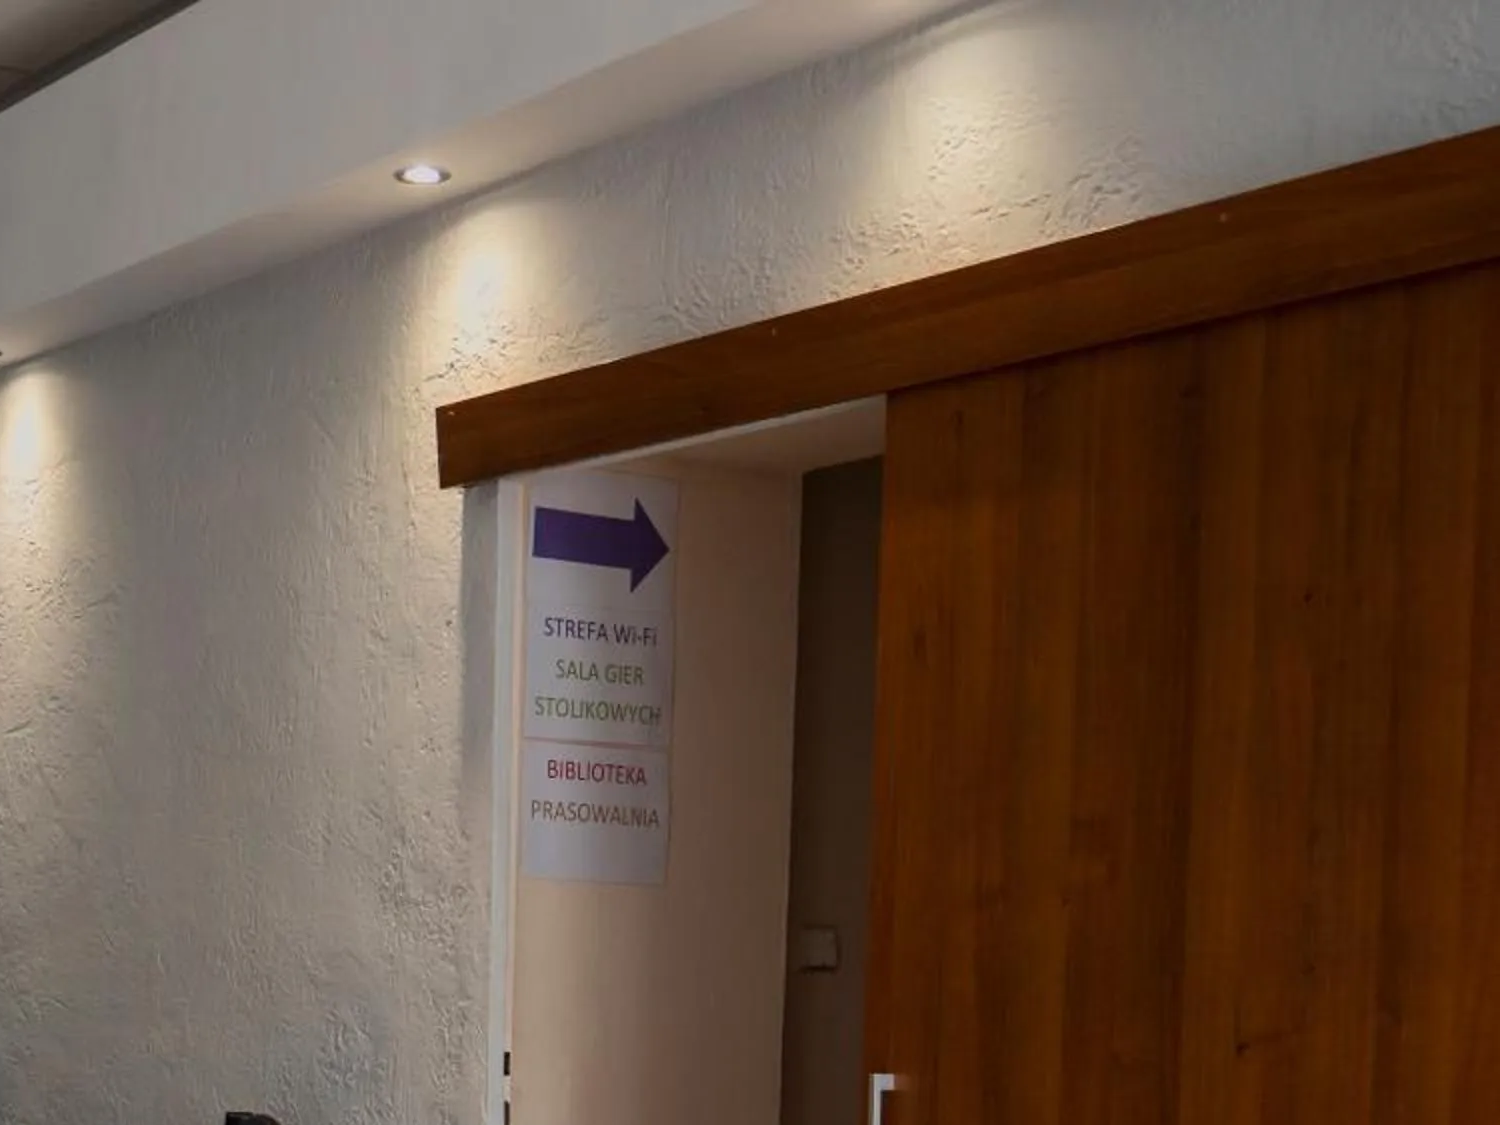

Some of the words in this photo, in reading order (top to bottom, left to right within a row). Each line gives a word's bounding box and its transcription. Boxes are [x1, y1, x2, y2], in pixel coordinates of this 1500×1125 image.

[543, 616, 609, 643] STREFA
[613, 623, 658, 648] Wi-Fi
[555, 658, 599, 682] SALA
[604, 663, 645, 686] GIER
[534, 695, 661, 727] STOLIKOWYCH
[547, 758, 648, 786] BIBLIOTEKA
[530, 799, 660, 829] PRASOWALNIA
